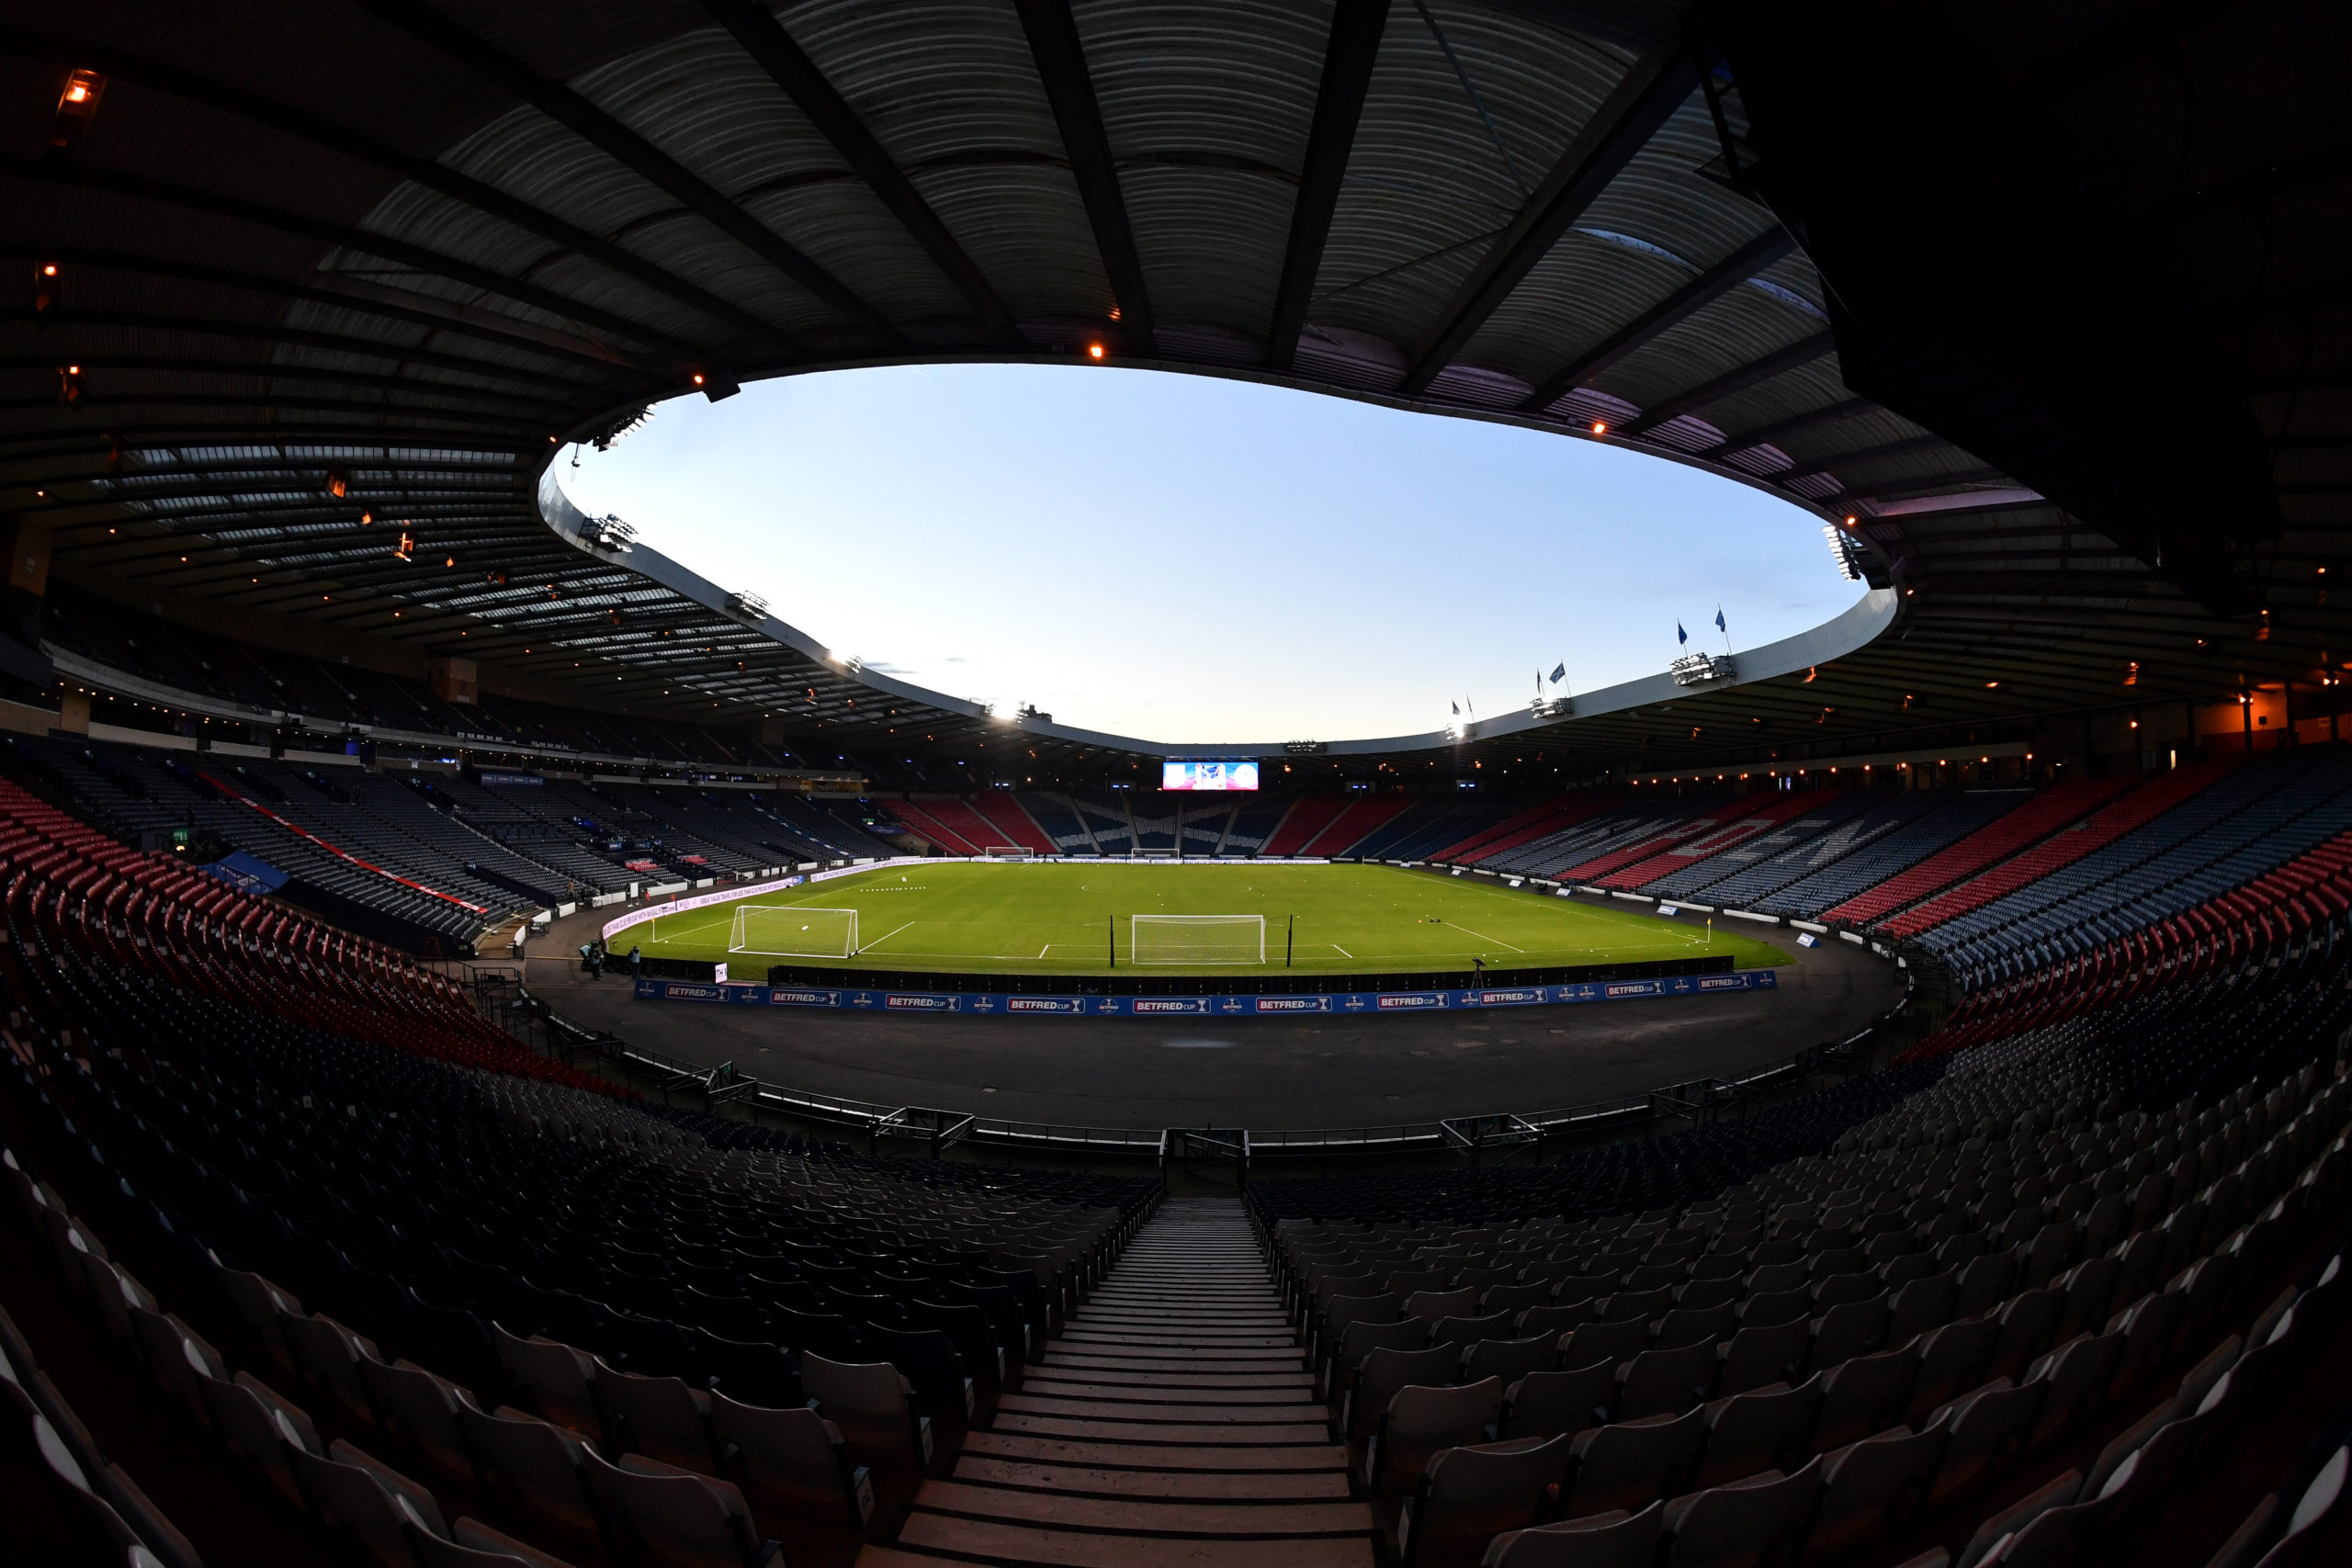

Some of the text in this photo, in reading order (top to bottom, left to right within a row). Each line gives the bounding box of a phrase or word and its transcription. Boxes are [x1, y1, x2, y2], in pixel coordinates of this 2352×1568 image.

[1702, 979, 1733, 987] BETFRED
[669, 987, 706, 997] BETFRED
[1609, 985, 1645, 995] BETFRED
[774, 993, 815, 1002] BETFRED
[1382, 998, 1423, 1006] BETFRED
[1484, 993, 1523, 1002] BETFRED
[889, 998, 933, 1007] BETFRED
[1012, 1000, 1057, 1010] BETFRED
[1137, 1002, 1183, 1010] BETFRED
[1260, 1000, 1305, 1010] BETFRED
